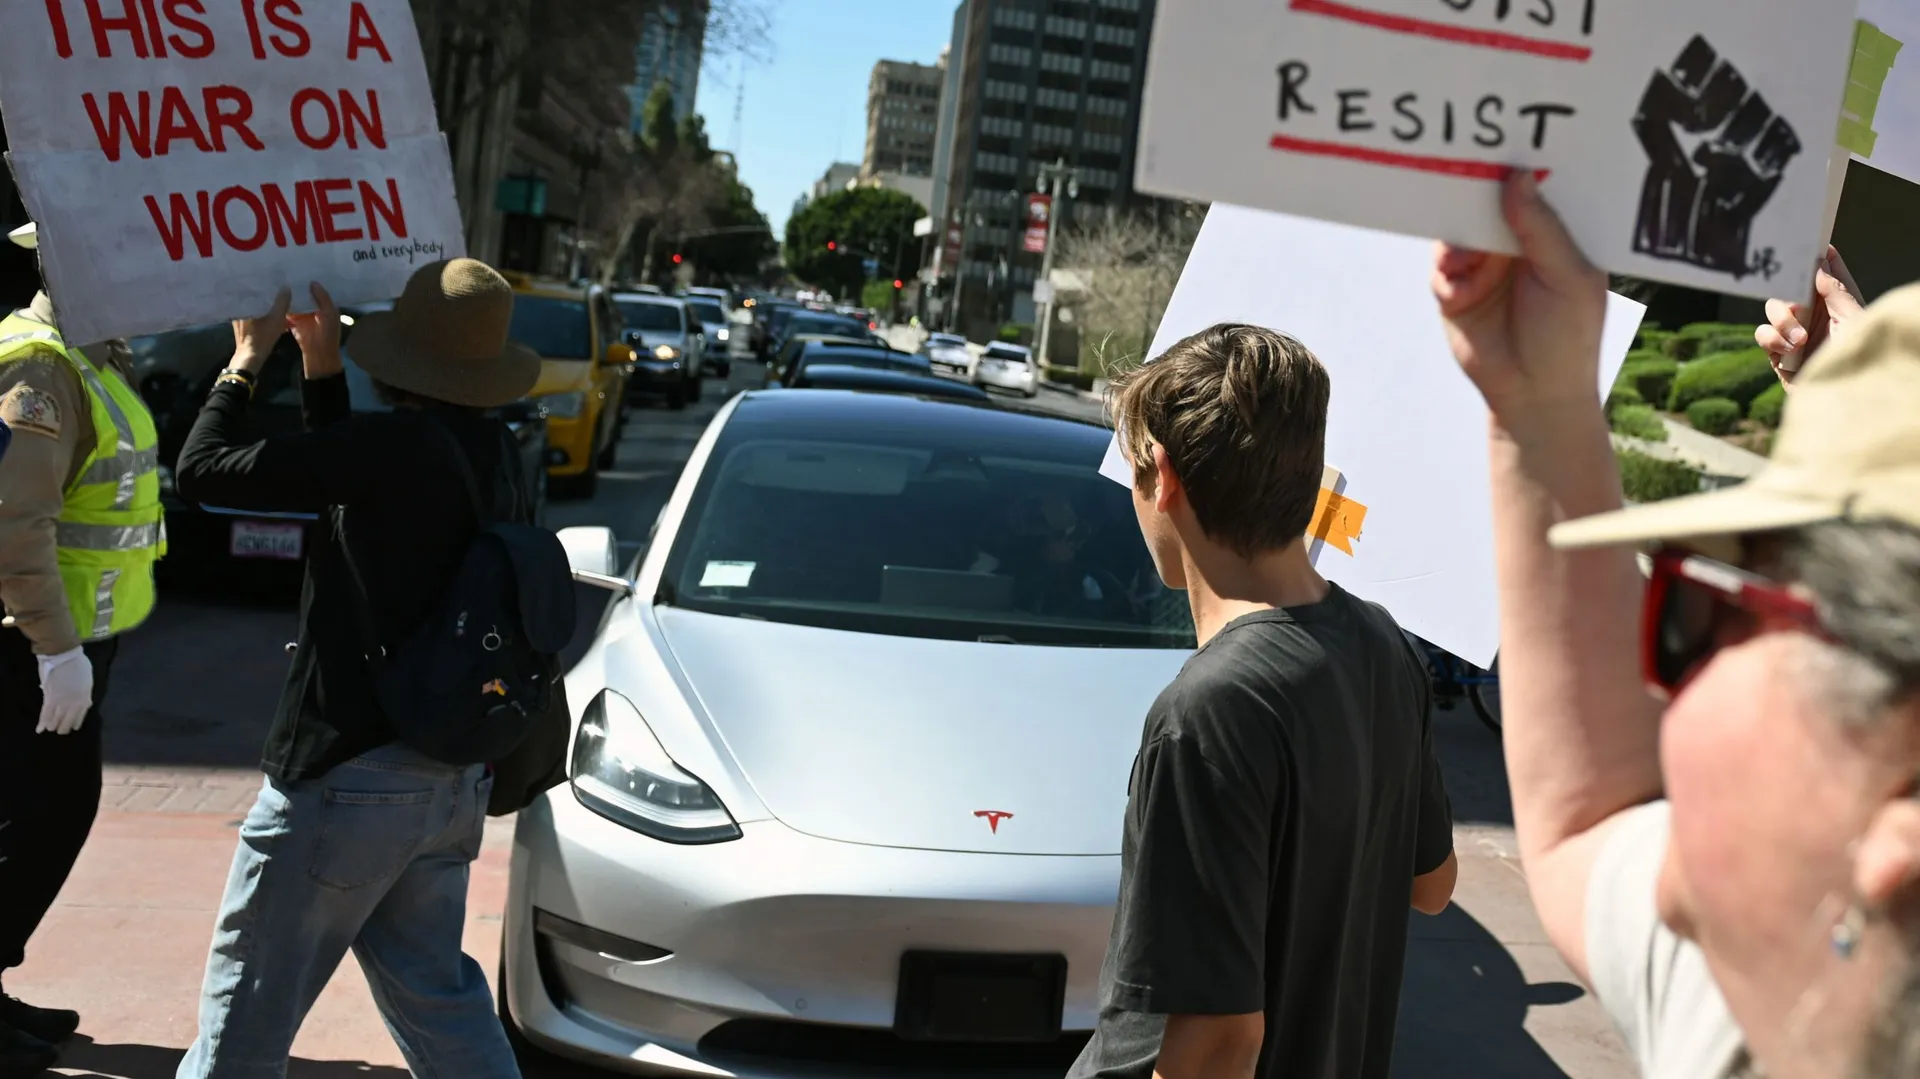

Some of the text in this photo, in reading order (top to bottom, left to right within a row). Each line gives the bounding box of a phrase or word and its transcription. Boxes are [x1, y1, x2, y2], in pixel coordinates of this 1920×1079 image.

[239, 0, 311, 60] IS
[346, 2, 393, 63] A
[81, 85, 387, 162] WAR ON
[1276, 60, 1576, 150] RESIST
[143, 178, 408, 261] WOMEN
[353, 236, 444, 264] and everybody
